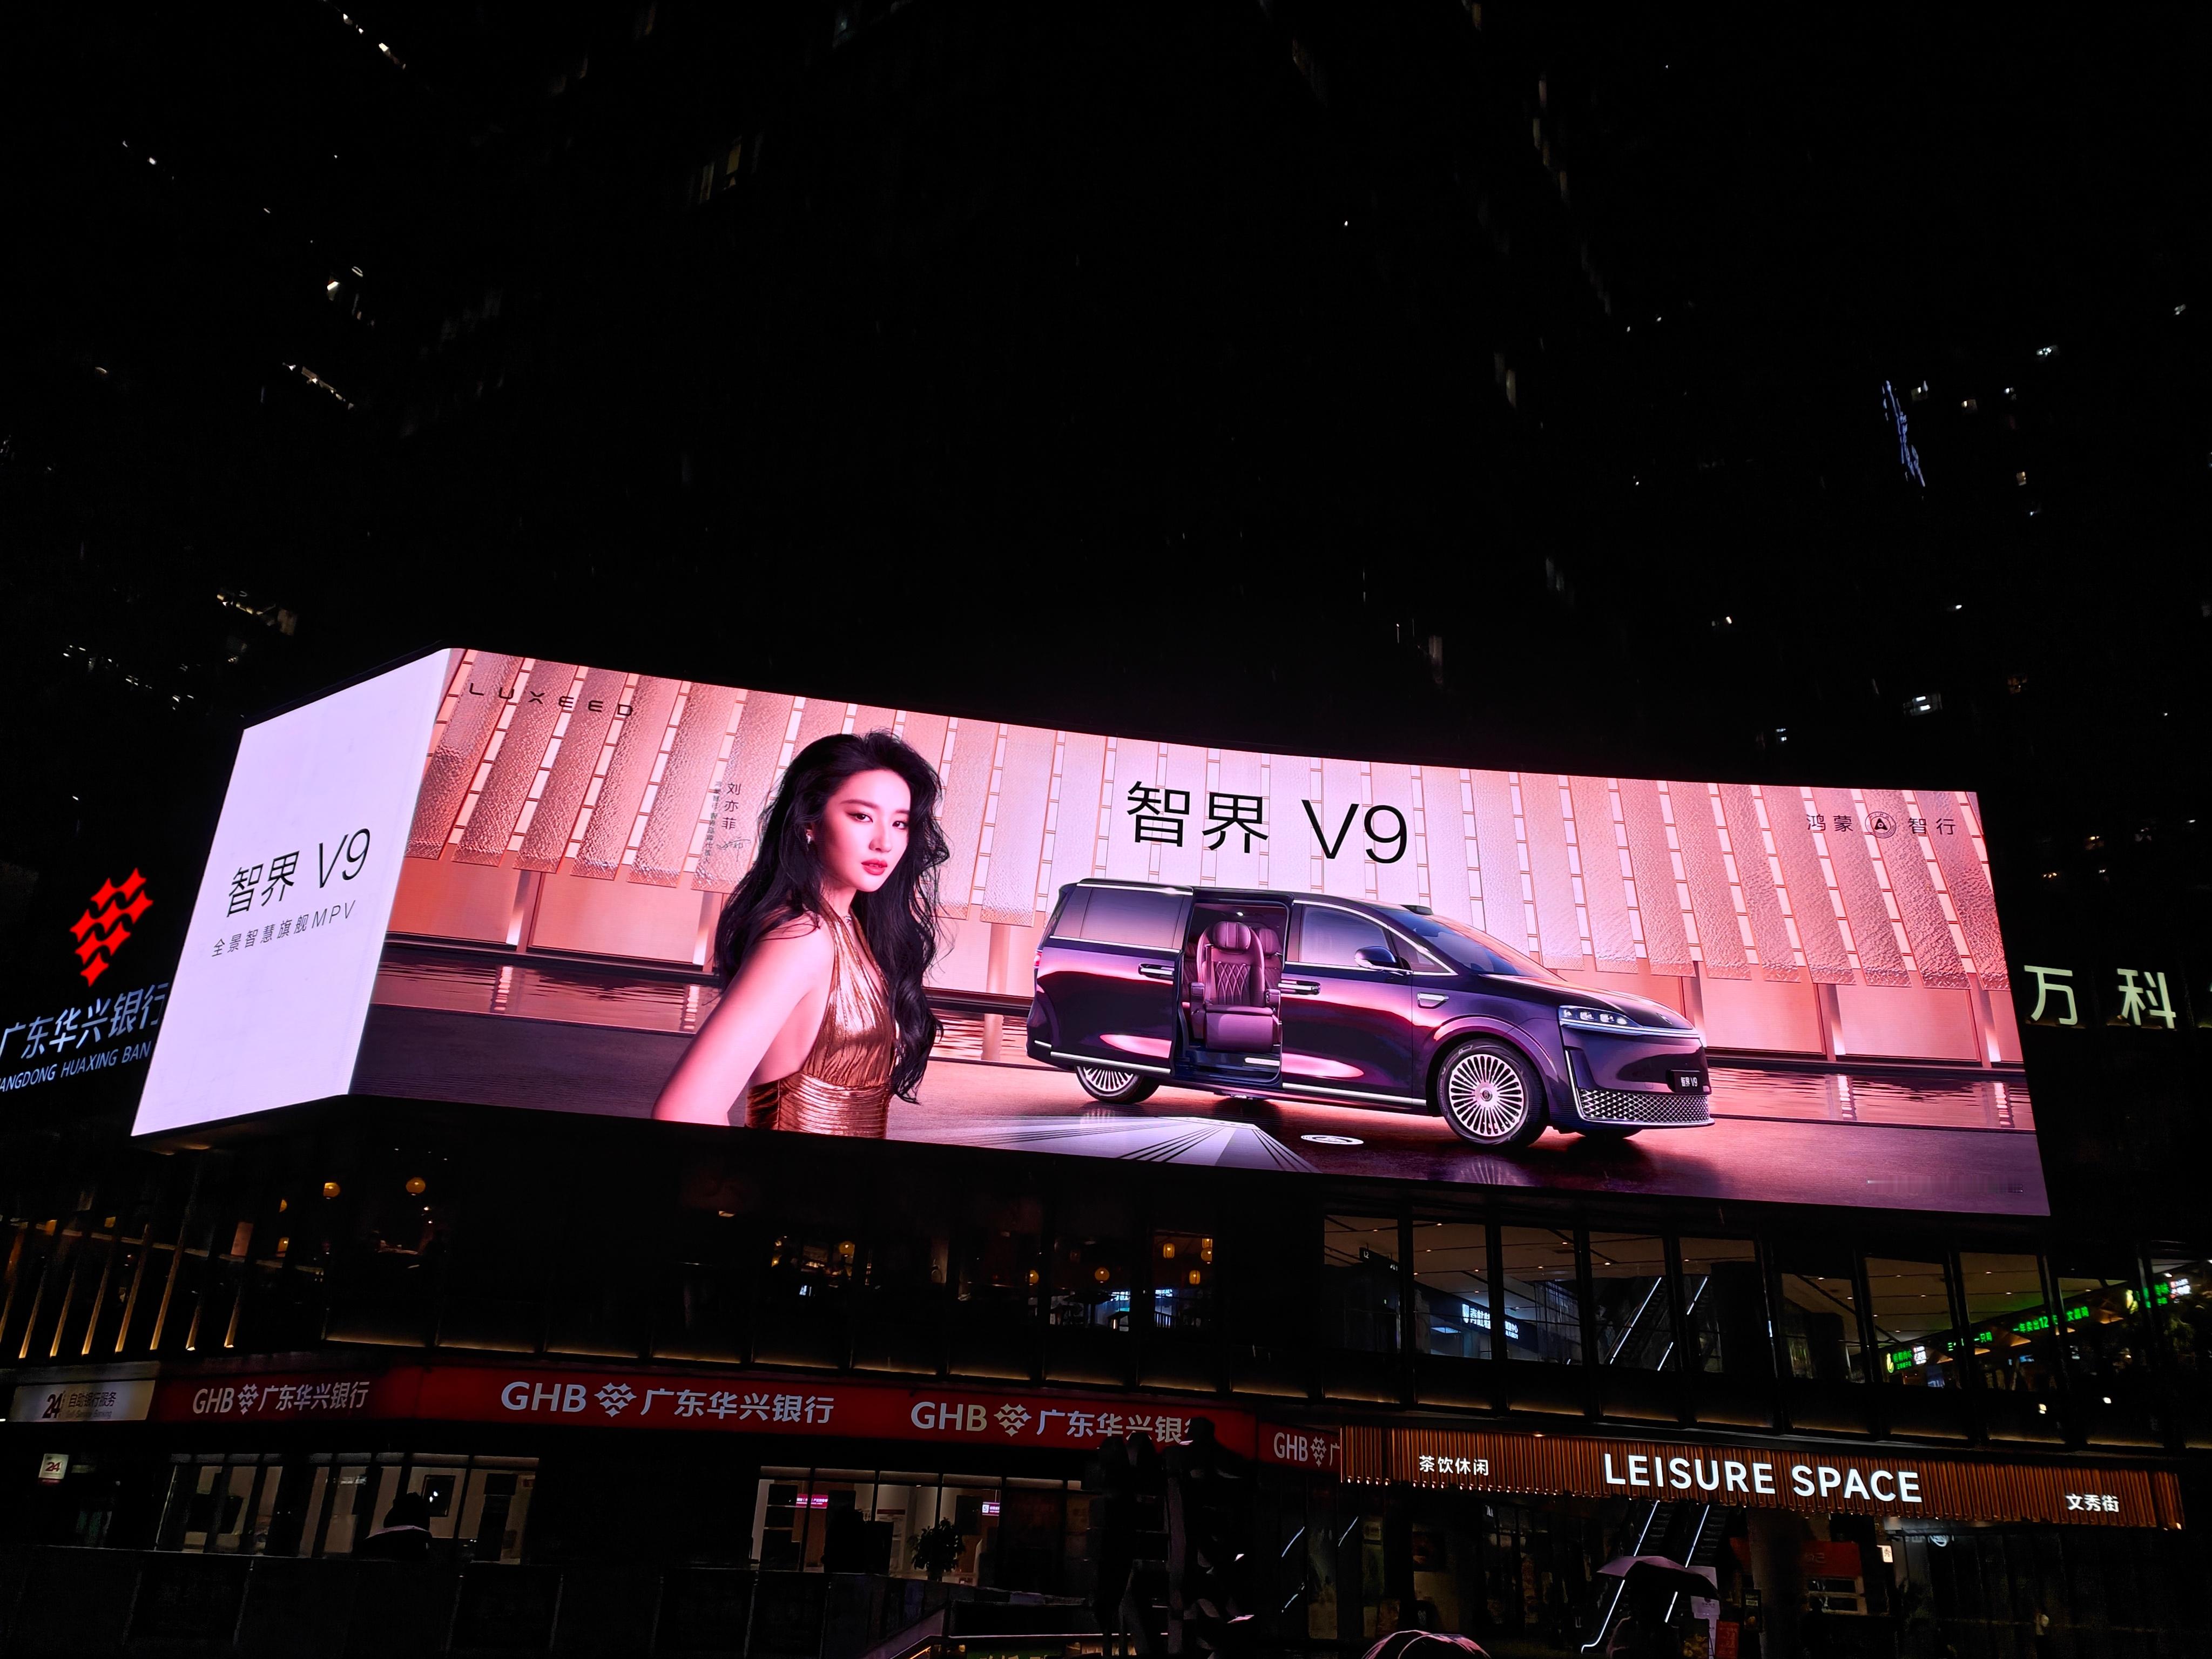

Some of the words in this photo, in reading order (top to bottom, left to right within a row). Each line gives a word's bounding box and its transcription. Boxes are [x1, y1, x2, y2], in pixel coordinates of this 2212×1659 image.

[468, 682, 634, 717] LUXEED
[721, 782, 741, 830] 刘亦菲
[1127, 781, 1269, 854] 智界
[1301, 799, 1407, 864] V9
[1806, 814, 1853, 832] 鸿蒙
[1908, 817, 1956, 835] 智行
[226, 851, 300, 918] 智界
[318, 828, 371, 889] V9
[2024, 965, 2176, 1029] 万科
[0, 982, 169, 1059] 广东华兴银行
[0, 1064, 57, 1092] ANGDONG
[60, 1048, 119, 1078] HUAXING
[122, 1040, 152, 1063] BAN
[42, 1392, 64, 1419] 24
[192, 1387, 235, 1414] GHB
[257, 1381, 370, 1412] 广东华兴银行
[501, 1381, 587, 1413] GHB
[640, 1387, 834, 1424] 广东华兴银行
[911, 1401, 988, 1432] GHB
[1273, 1432, 1309, 1462] GHB
[45, 1462, 61, 1472] 24
[1419, 1455, 1489, 1476] 茶饮休闲
[1604, 1453, 1776, 1495] LEISURE
[1791, 1465, 1923, 1503] SPACE
[2065, 1493, 2120, 1513] 文秀街
